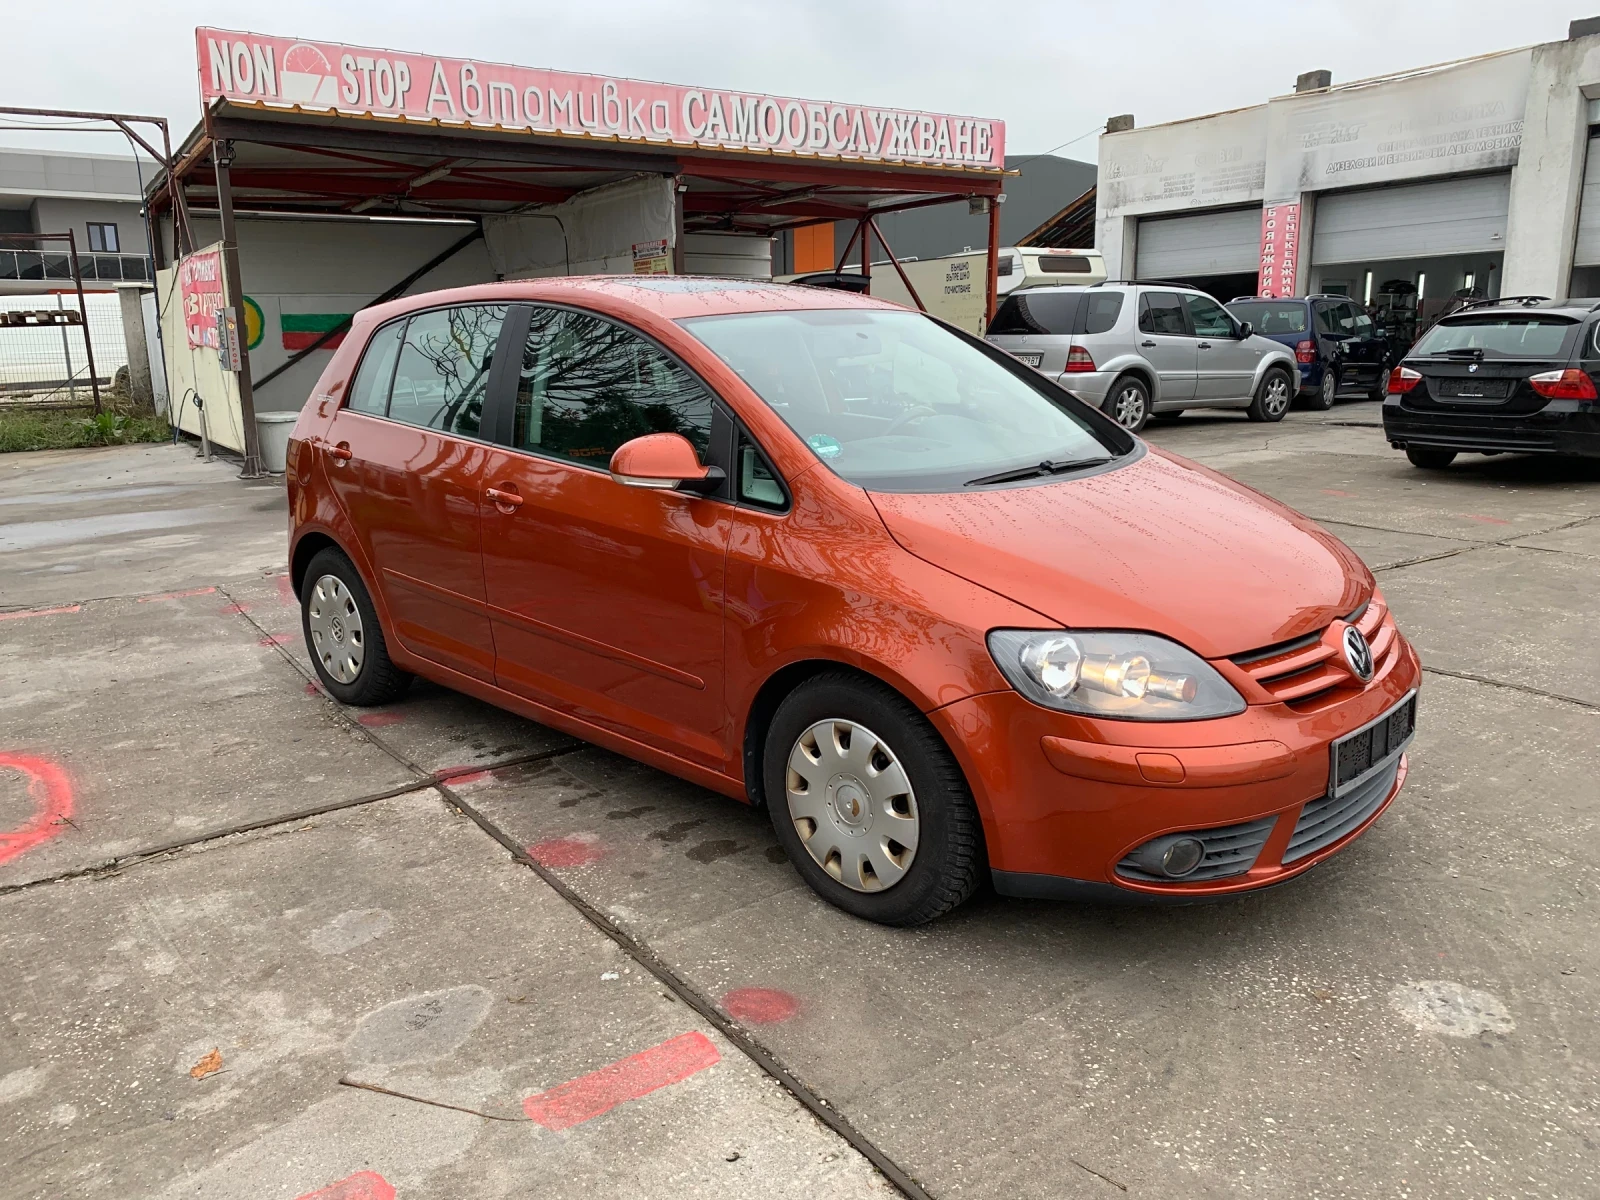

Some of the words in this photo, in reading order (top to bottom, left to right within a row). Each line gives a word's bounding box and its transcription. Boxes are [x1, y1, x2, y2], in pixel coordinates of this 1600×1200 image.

[207, 38, 279, 97] NON
[341, 53, 412, 109] STOP
[426, 59, 673, 137] Автомивка
[682, 90, 994, 162] САМООБСЛУЖВАНЕ
[1326, 156, 1376, 174] ДИЗЕЛОВИ
[1386, 147, 1446, 164] БЕНЗИНОВИ
